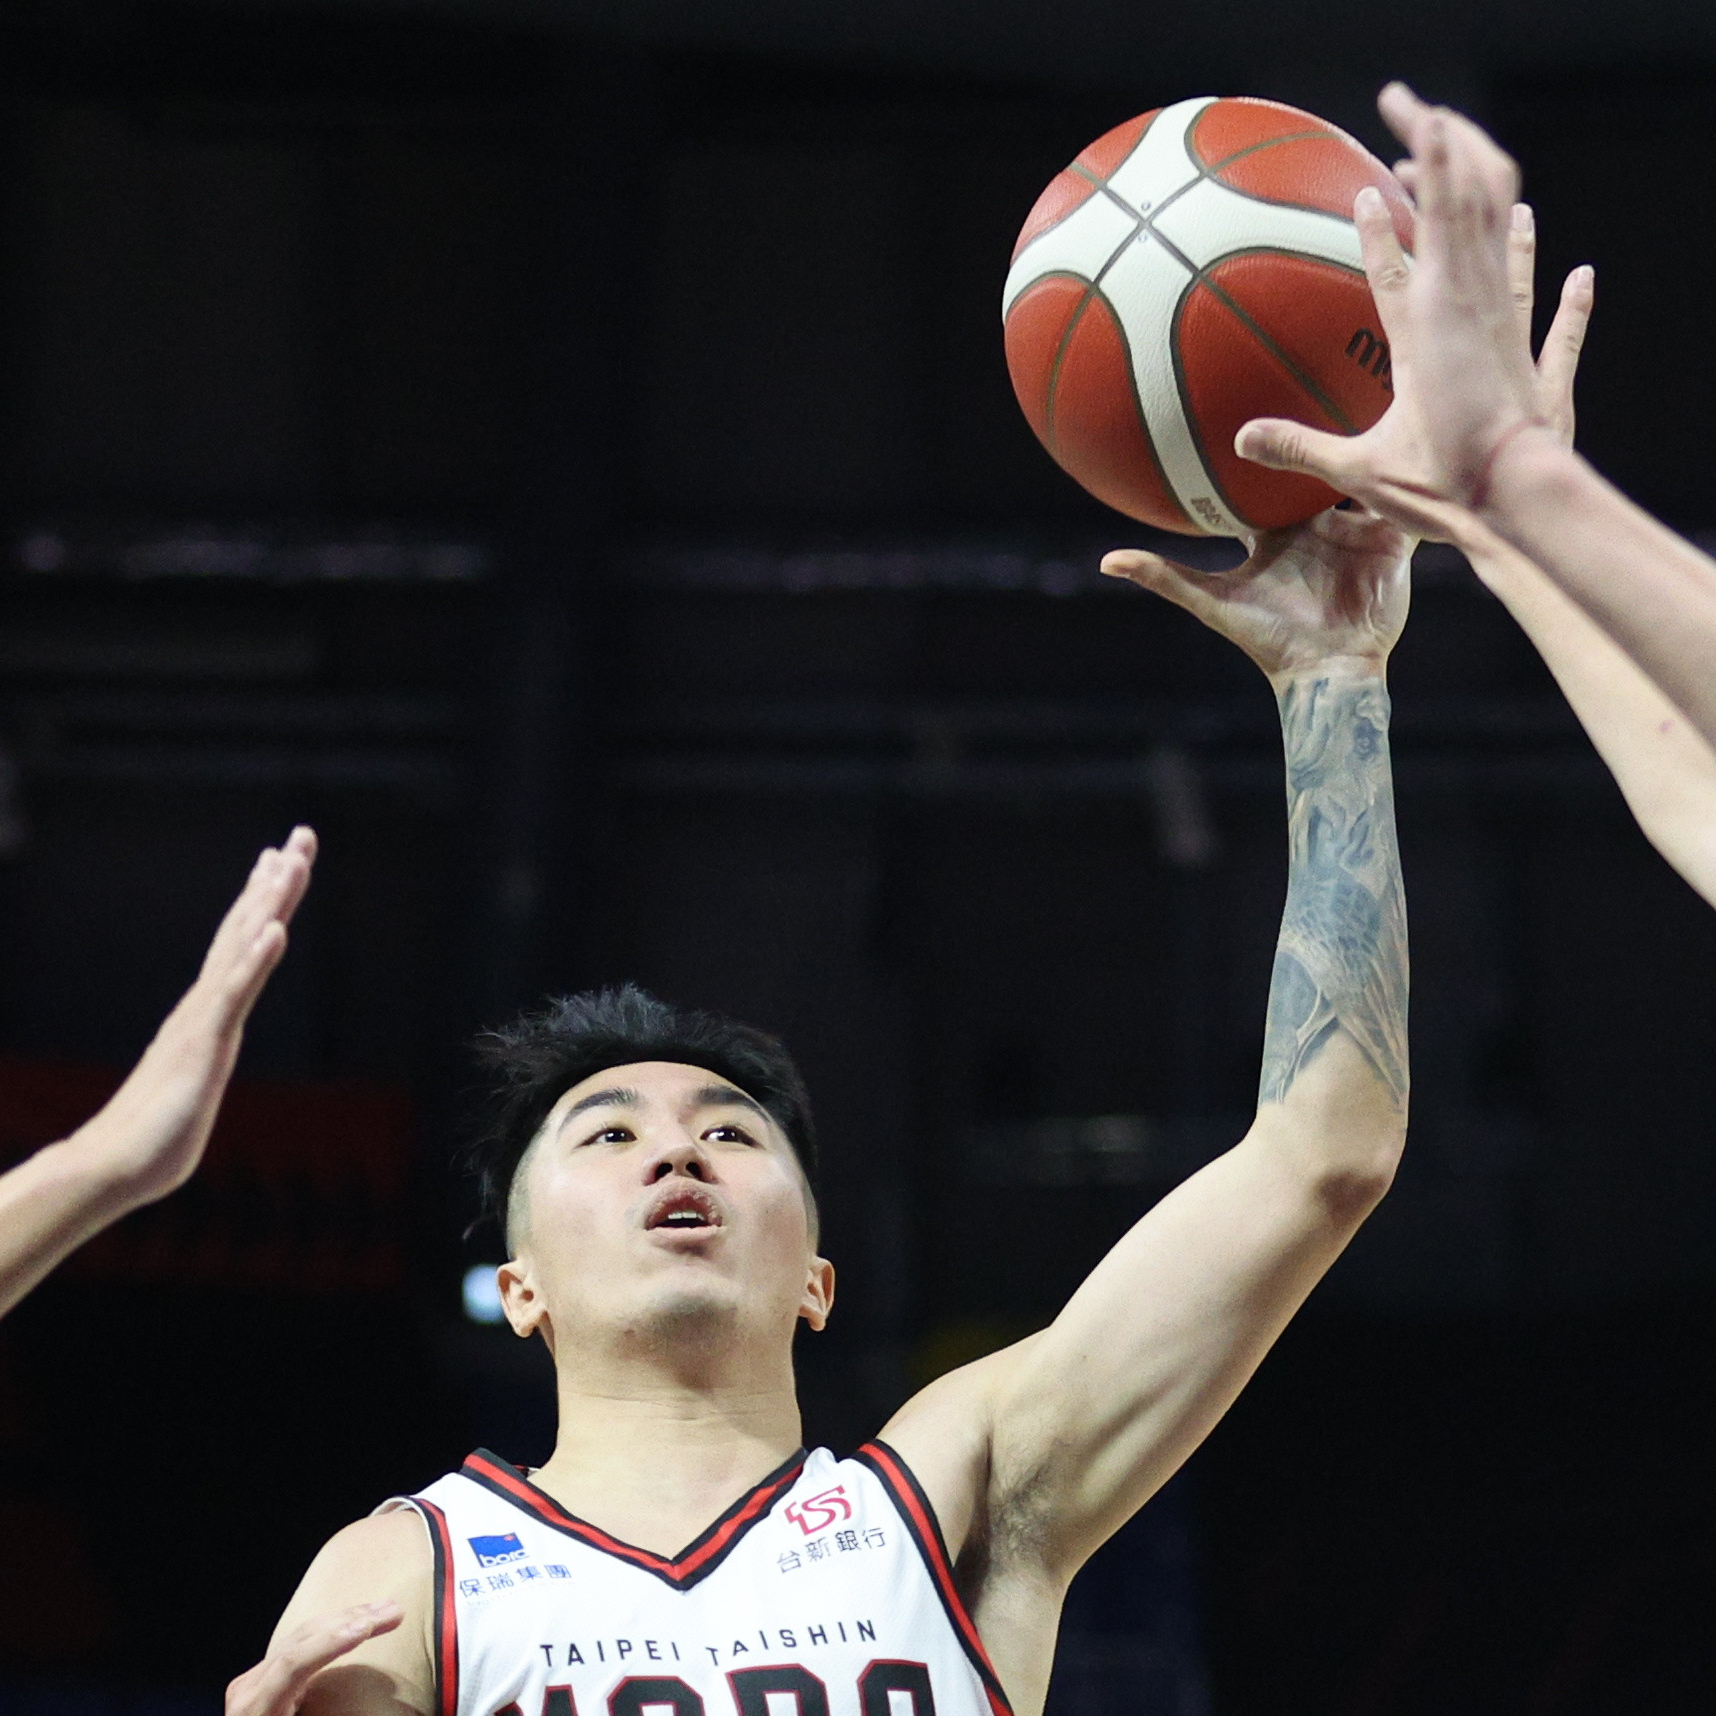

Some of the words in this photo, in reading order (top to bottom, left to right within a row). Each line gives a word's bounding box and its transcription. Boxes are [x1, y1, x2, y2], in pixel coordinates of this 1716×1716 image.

[777, 1527, 886, 1574] 台新銀行
[540, 1639, 681, 1668] TAIPEI
[705, 1620, 877, 1667] TAISHIN
